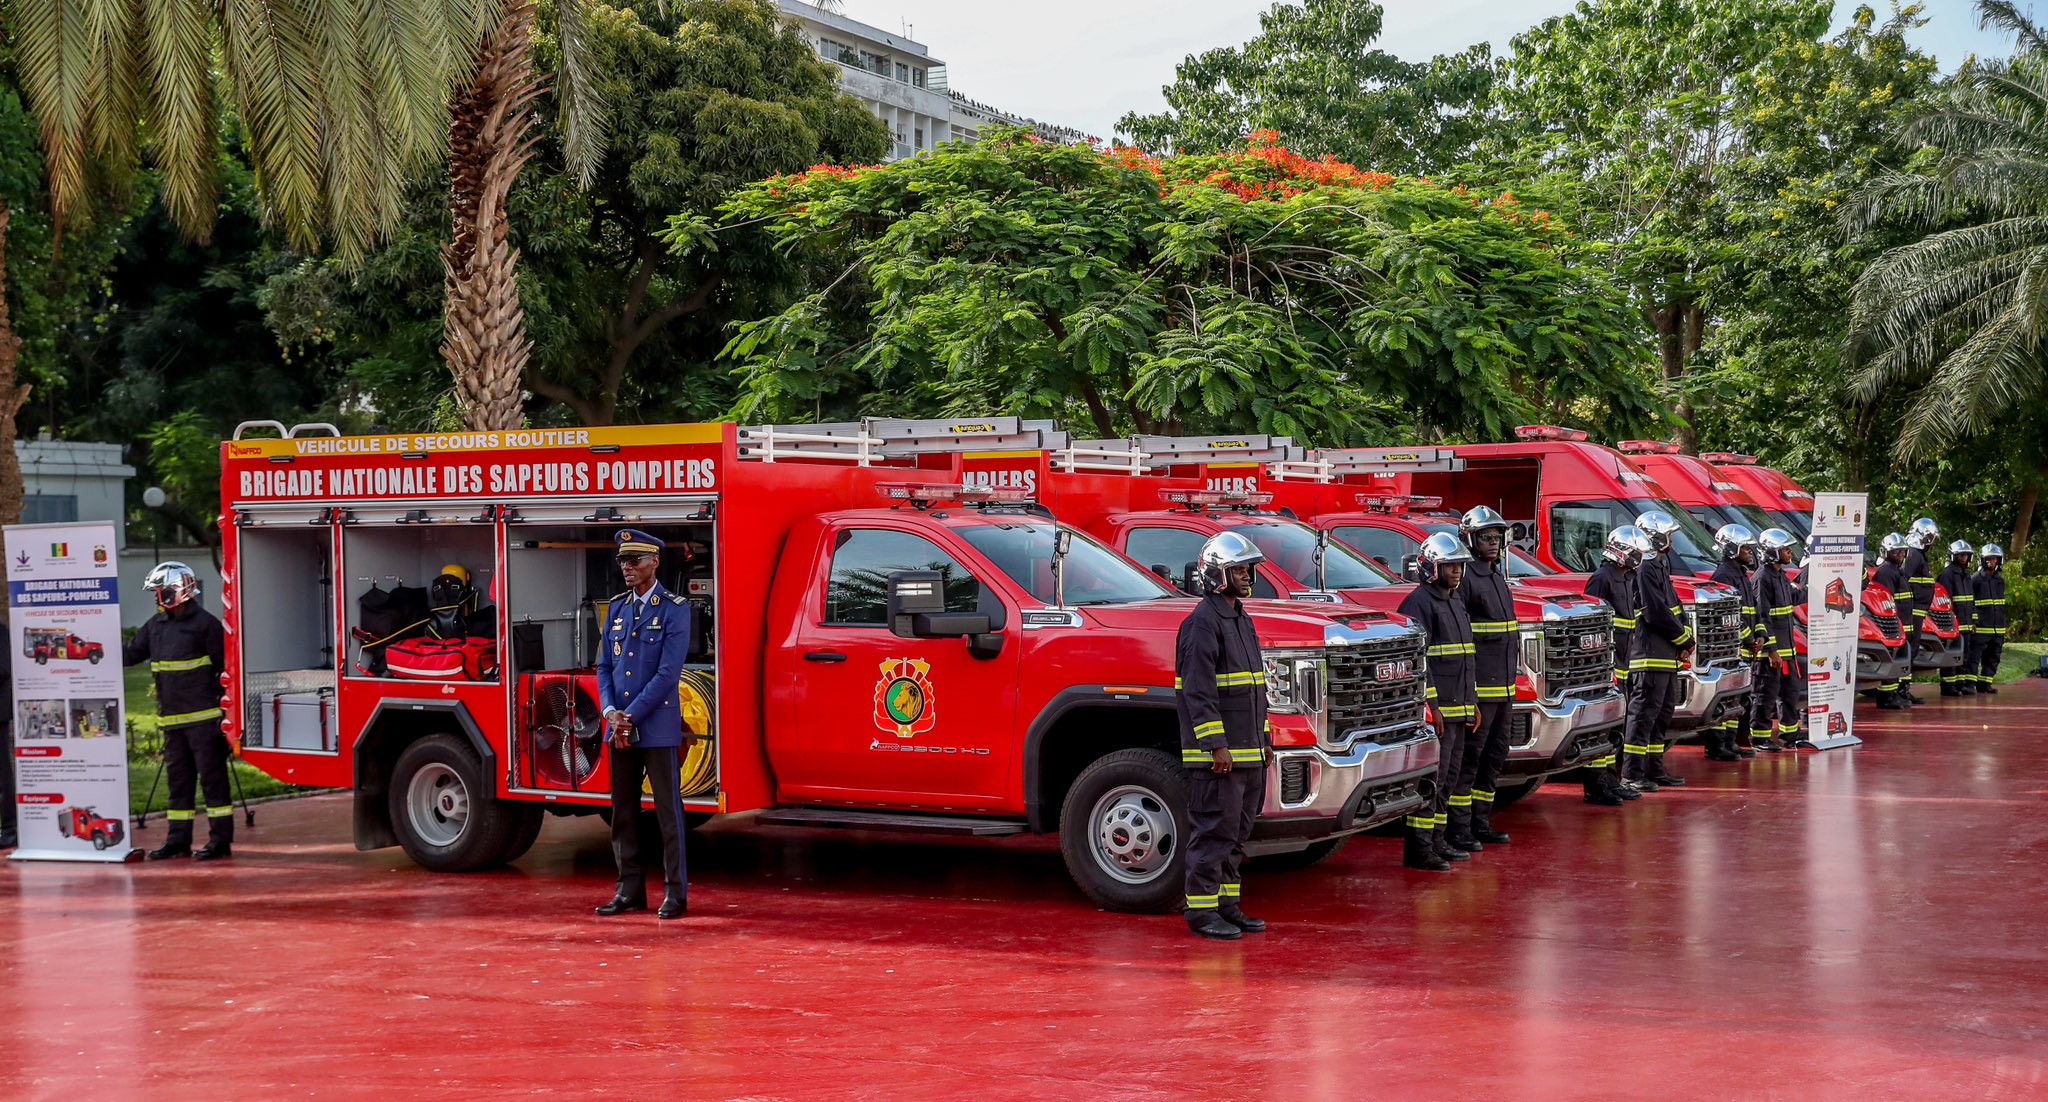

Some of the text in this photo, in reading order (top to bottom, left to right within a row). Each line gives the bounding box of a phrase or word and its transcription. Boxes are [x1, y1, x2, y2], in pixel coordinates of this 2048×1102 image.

[295, 430, 590, 454] VEHICULE DE SECOURS ROUTIER
[240, 458, 716, 497] BRIGADE NATIONALE DES SAPEURS POMPIERS
[25, 579, 100, 592] BRIGADE NATIONALE
[17, 591, 110, 603] DES SAPEURS-POMPIERS
[1580, 632, 1608, 650] GMC
[1376, 660, 1414, 681] GMC
[961, 747, 990, 755] HD
